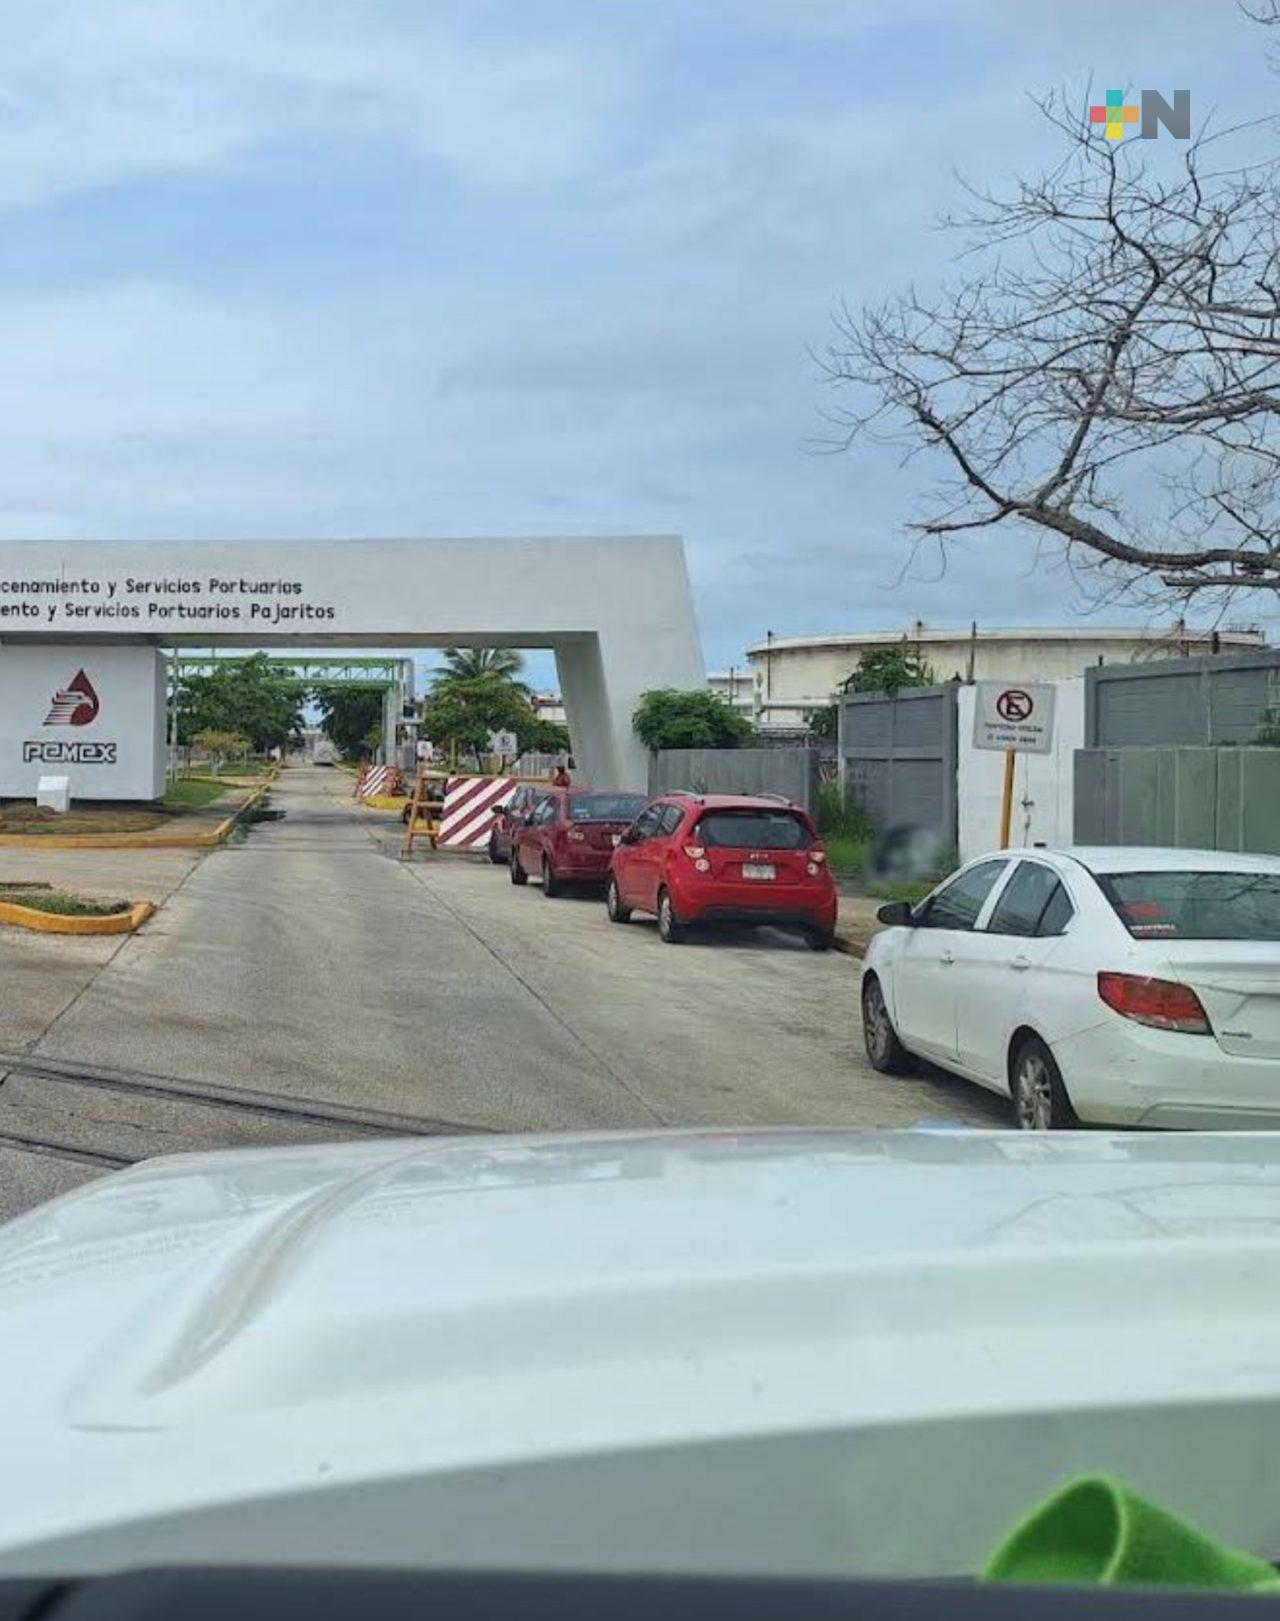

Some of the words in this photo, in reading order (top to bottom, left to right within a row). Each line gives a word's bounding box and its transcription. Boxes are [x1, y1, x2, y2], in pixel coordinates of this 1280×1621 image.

[107, 582, 117, 598] y
[125, 578, 201, 594] Servicios
[209, 578, 302, 595] Portuarios
[47, 604, 57, 621] y
[65, 602, 140, 618] Servicios
[149, 602, 240, 619] Portuarios
[250, 603, 335, 624] Pajaritos
